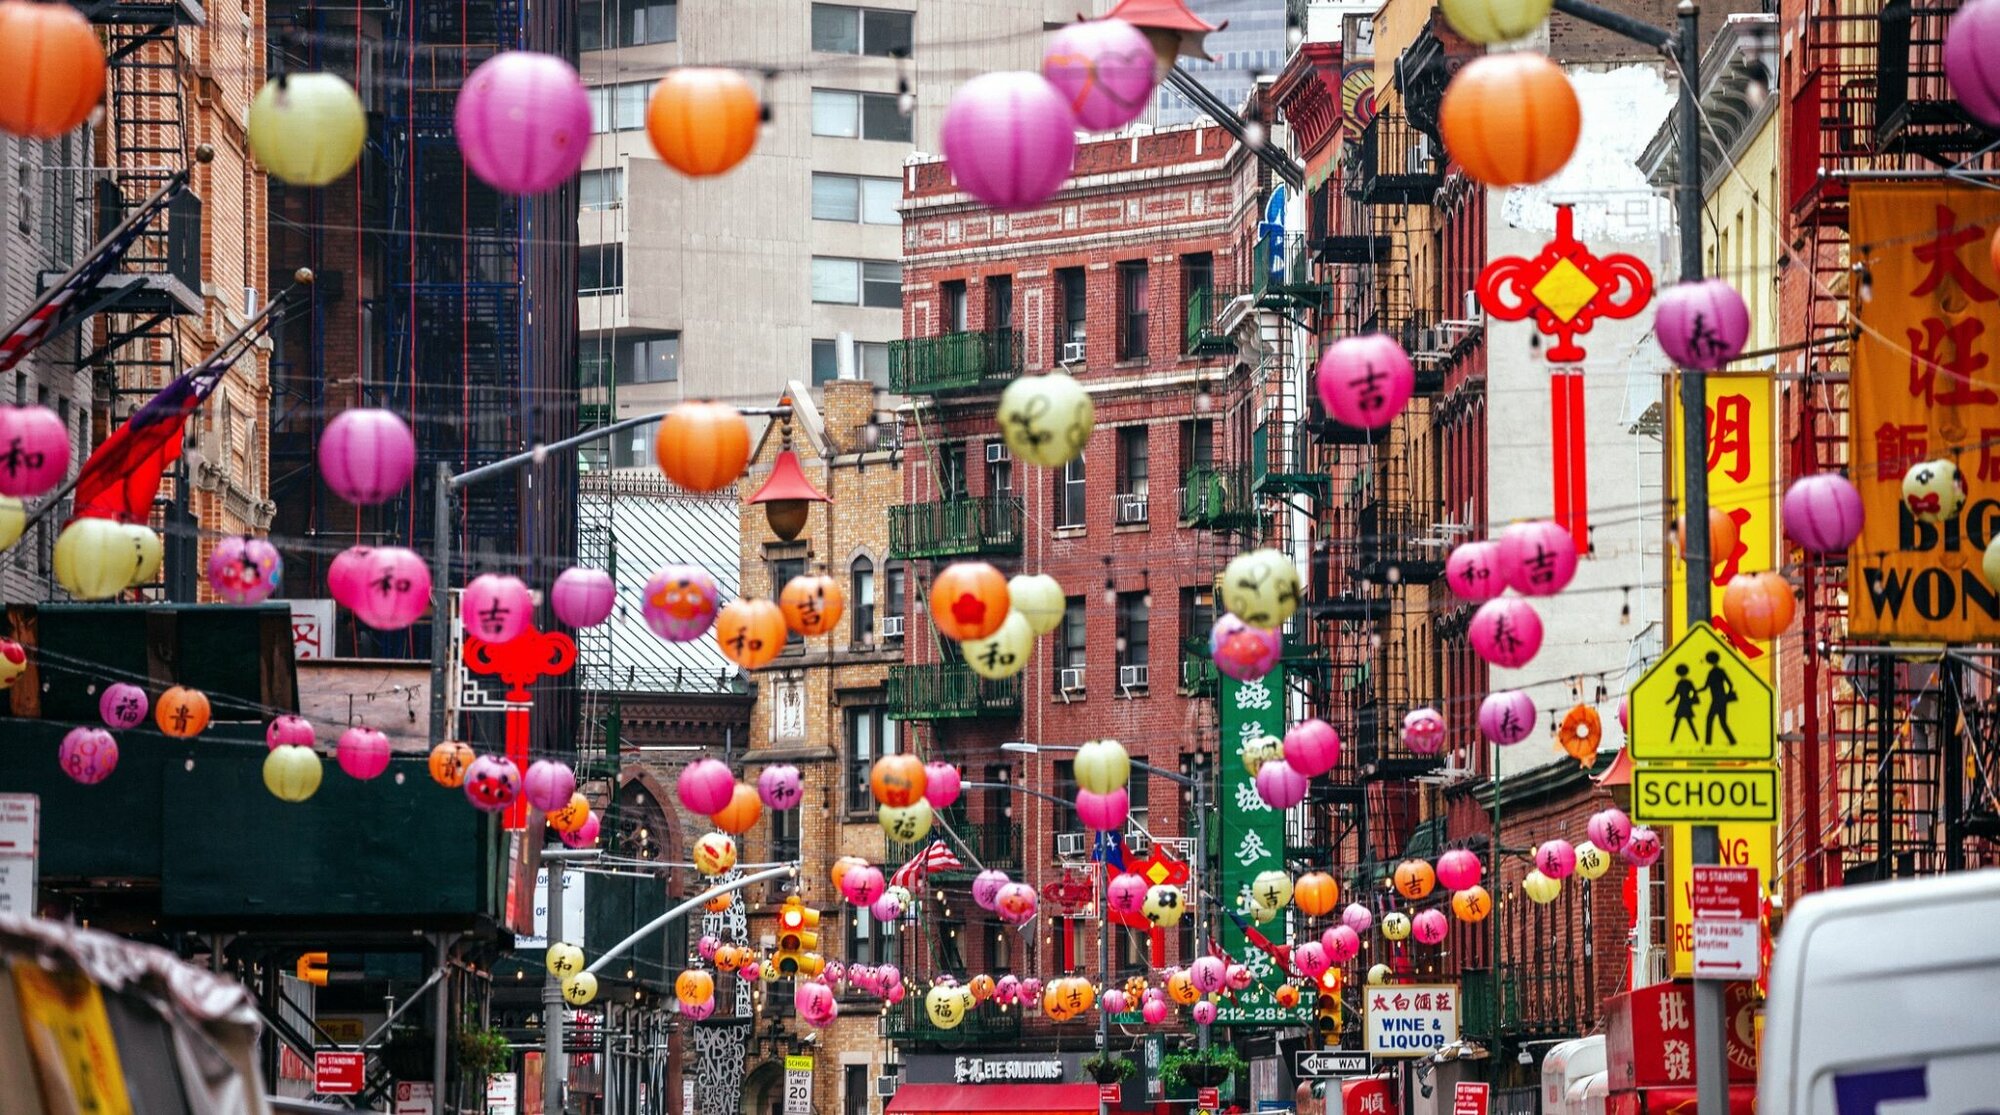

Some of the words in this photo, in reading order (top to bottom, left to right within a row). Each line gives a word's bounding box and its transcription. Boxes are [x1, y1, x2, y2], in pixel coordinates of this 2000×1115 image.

[1349, 364, 1388, 412] 吉
[0, 437, 44, 478] 和
[1460, 559, 1489, 583] 和
[1526, 546, 1557, 584] 吉
[370, 571, 411, 597] 和
[478, 597, 510, 634] 吉
[726, 627, 762, 657] 和
[978, 648, 1015, 670] 和
[115, 696, 138, 722] 福
[771, 781, 796, 800] 和
[1644, 781, 1767, 806] SCHOOL
[893, 813, 917, 839] 福
[1606, 823, 1625, 848] 春
[1581, 850, 1599, 870] 福
[1404, 874, 1423, 893] 吉
[1695, 872, 1707, 880] NO
[1709, 872, 1748, 881] STANDING
[1116, 889, 1133, 908] 吉
[1263, 886, 1281, 908] 吉
[1697, 927, 1707, 935] NO
[1710, 927, 1744, 936] PARKING
[1697, 940, 1728, 949] Anytime
[554, 957, 572, 972] 和
[568, 983, 586, 998] 和
[1065, 989, 1081, 1008] 吉
[1180, 981, 1193, 999] 吉
[934, 998, 953, 1018] 福
[1382, 1018, 1424, 1031] WINE
[1433, 1018, 1441, 1031] &
[1379, 1034, 1445, 1049] LIQUOR
[1658, 991, 1691, 1081] 批發
[319, 1066, 342, 1075] Anytime
[328, 1057, 356, 1065] STANDING
[985, 1061, 1004, 1079] EYE
[1005, 1061, 1062, 1079] SOLUTIONS
[1308, 1059, 1328, 1069] ONE
[1339, 1058, 1361, 1069] WAY
[789, 1086, 807, 1099] 20
[1359, 1093, 1386, 1114] 順
